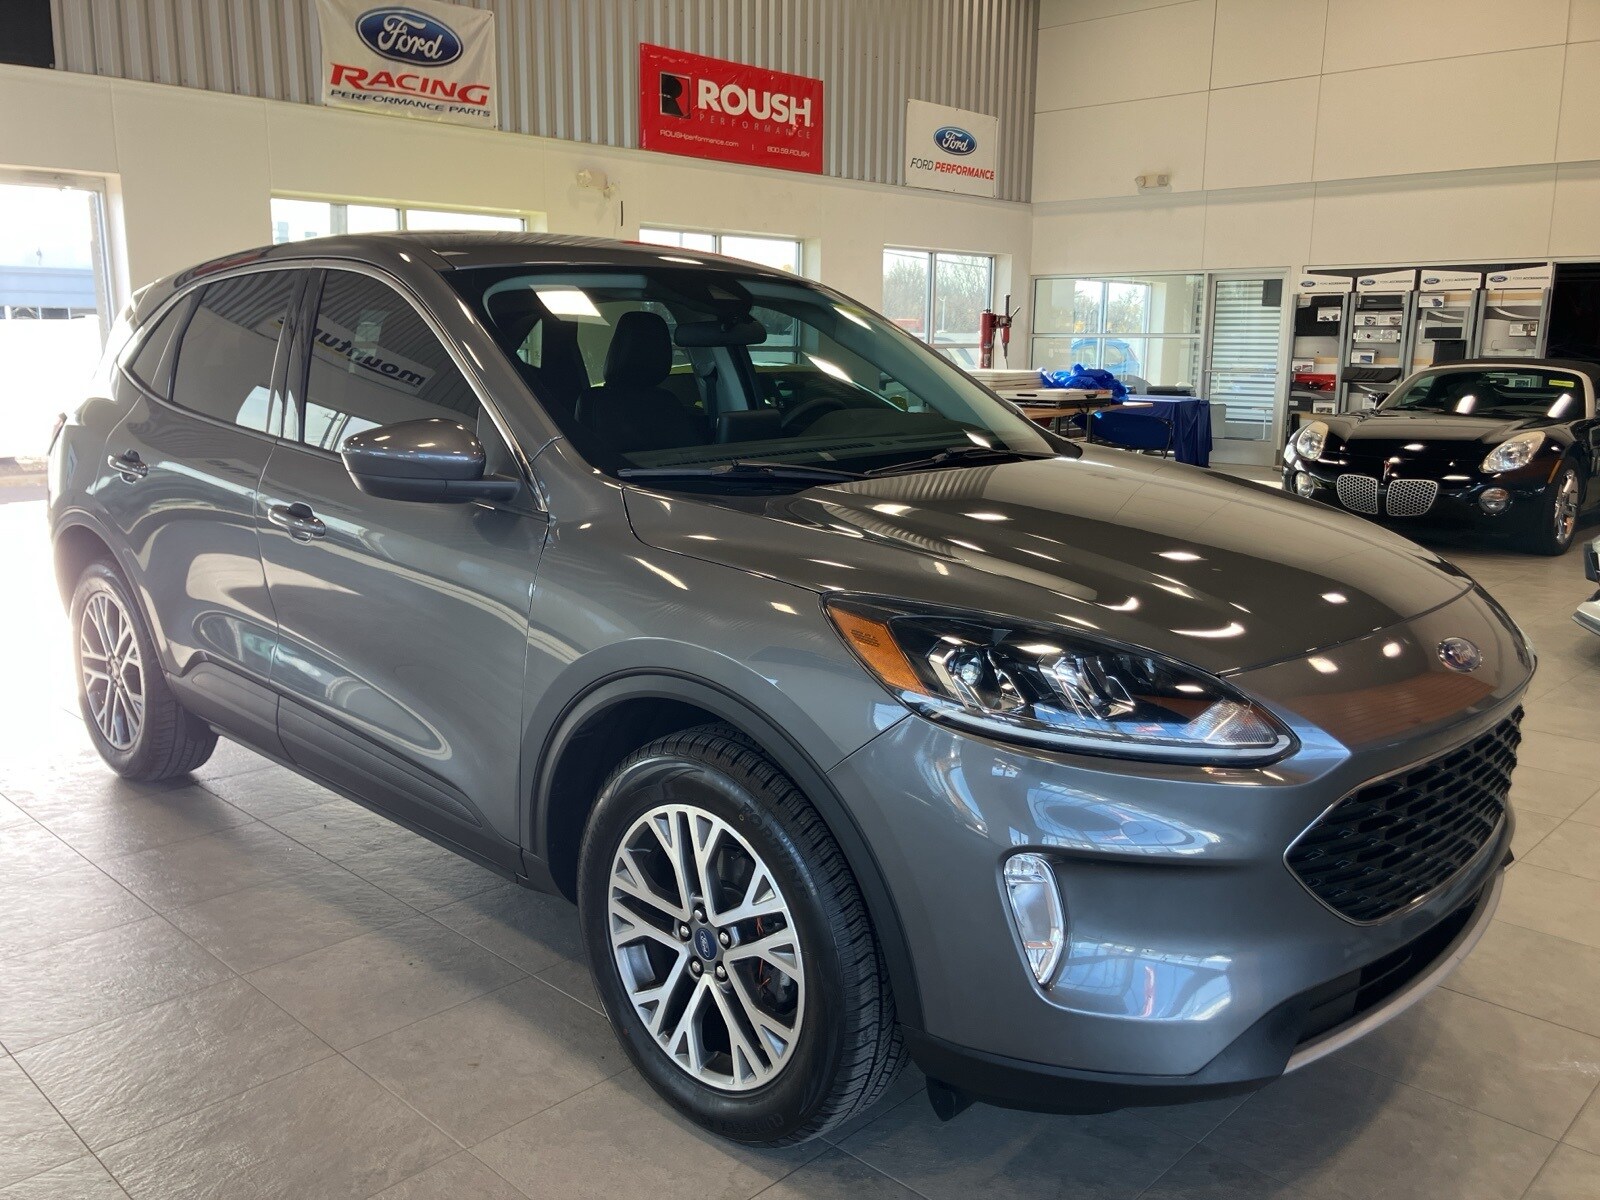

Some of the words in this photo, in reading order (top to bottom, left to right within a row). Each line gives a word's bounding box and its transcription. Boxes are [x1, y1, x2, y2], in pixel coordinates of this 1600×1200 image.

[377, 14, 443, 59] Ford
[330, 62, 490, 106] RACING
[330, 89, 444, 111] PERFORMANCE
[448, 106, 491, 117] PARTS
[697, 78, 812, 128] ROUSH
[700, 114, 811, 139] PERFORMANCE
[942, 130, 969, 152] Ford
[910, 157, 934, 171] FORD
[934, 161, 995, 181] PERFORMANCE
[700, 930, 711, 958] Ford
